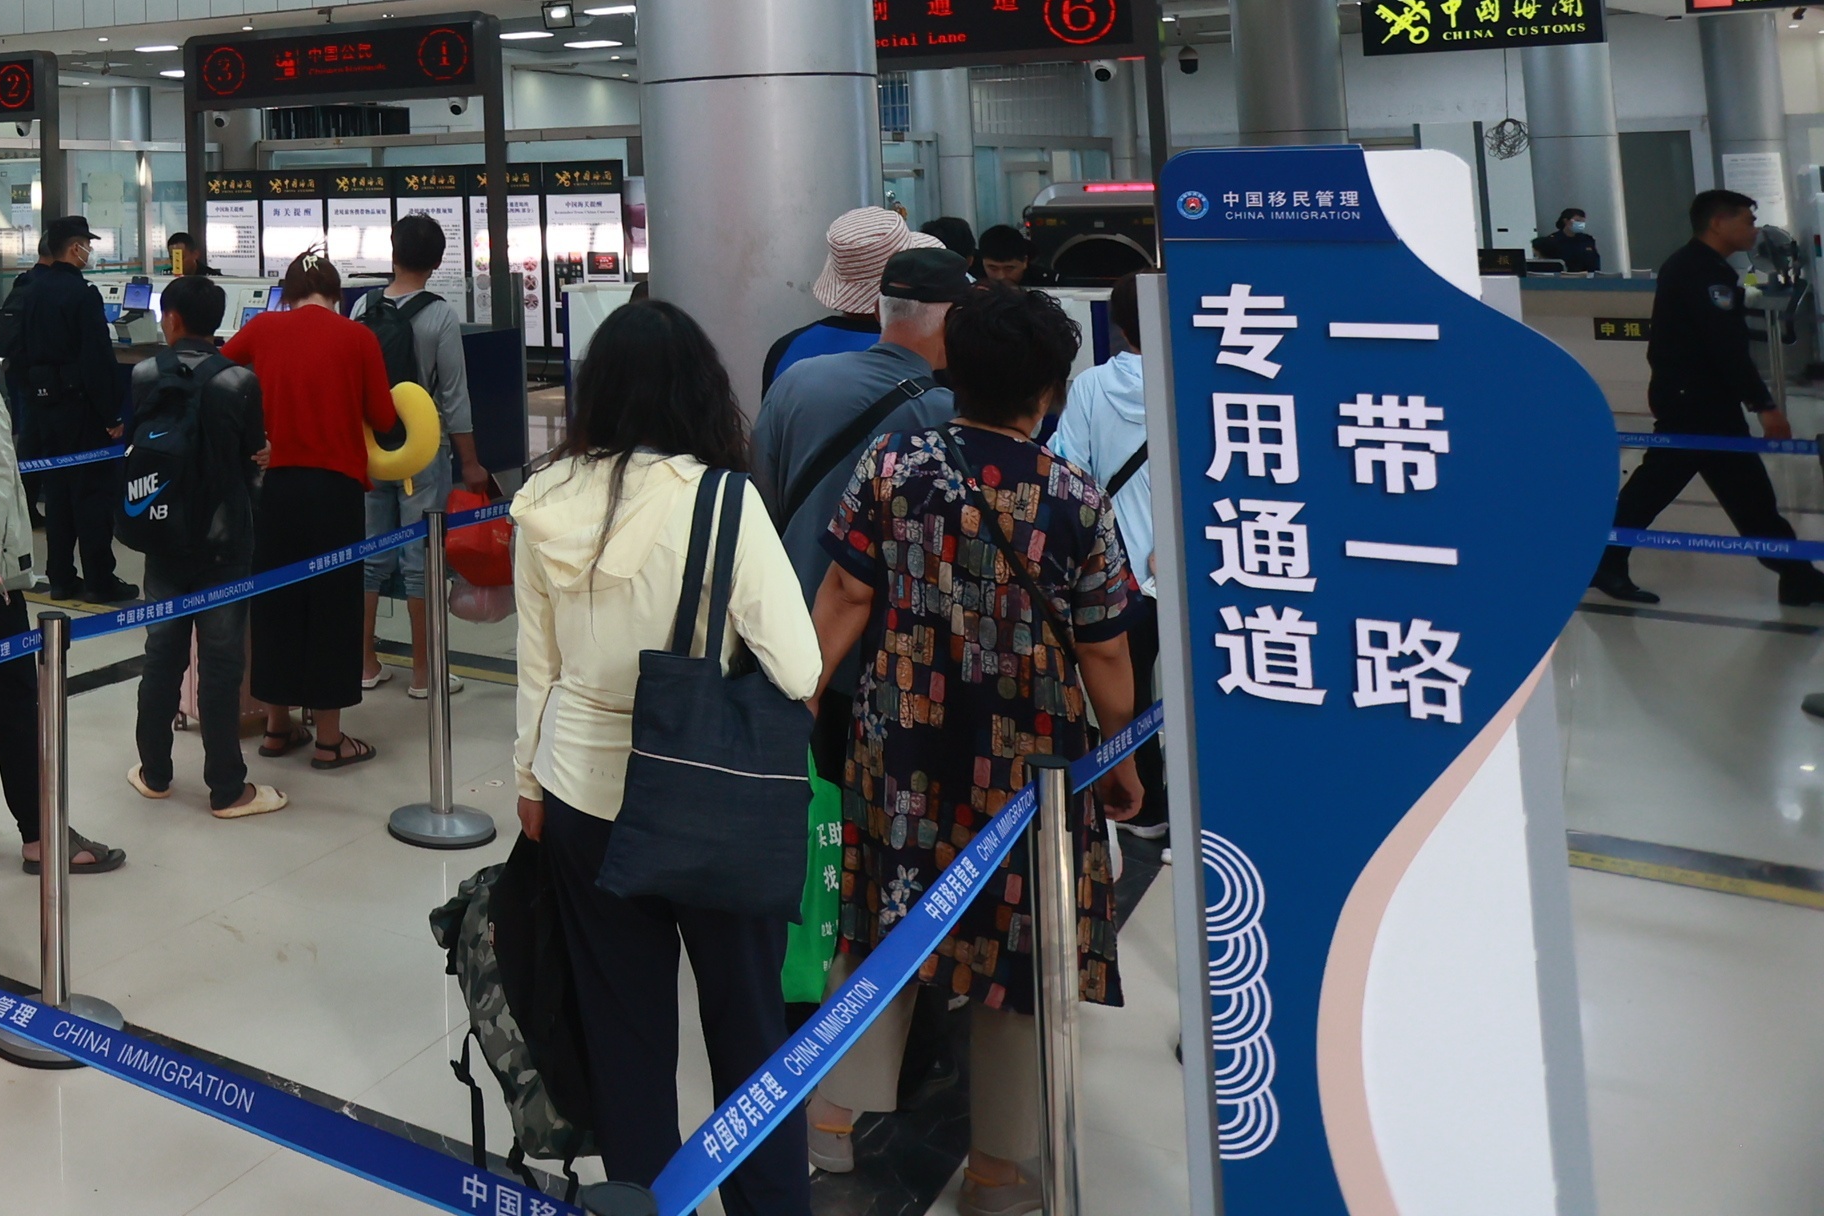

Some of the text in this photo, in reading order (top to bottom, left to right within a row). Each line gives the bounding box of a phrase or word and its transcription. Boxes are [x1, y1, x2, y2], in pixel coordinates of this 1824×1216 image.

[928, 32, 967, 45] Lane
[1442, 23, 1586, 41] CHINA CUSTOMS
[1223, 190, 1360, 207] 中国移民管理
[1225, 211, 1360, 220] CHINA IMMIGRATION
[128, 472, 159, 501] NIKE
[1193, 283, 1327, 706] 专用通道
[150, 504, 168, 520] NB
[1329, 322, 1472, 724] 一带一路
[309, 548, 353, 573] 中国移民管理
[359, 541, 377, 555] CHINA
[117, 580, 254, 627] 中国移民管理 CHINA IMMIGRATION
[923, 787, 1036, 922] 中国移民管理 CHINA IMMIGRATION
[53, 1020, 111, 1058] CHINA
[117, 1043, 255, 1113] IMMIGRATION
[702, 977, 880, 1164] 中国移民管理 CHINA IMMIGRATION
